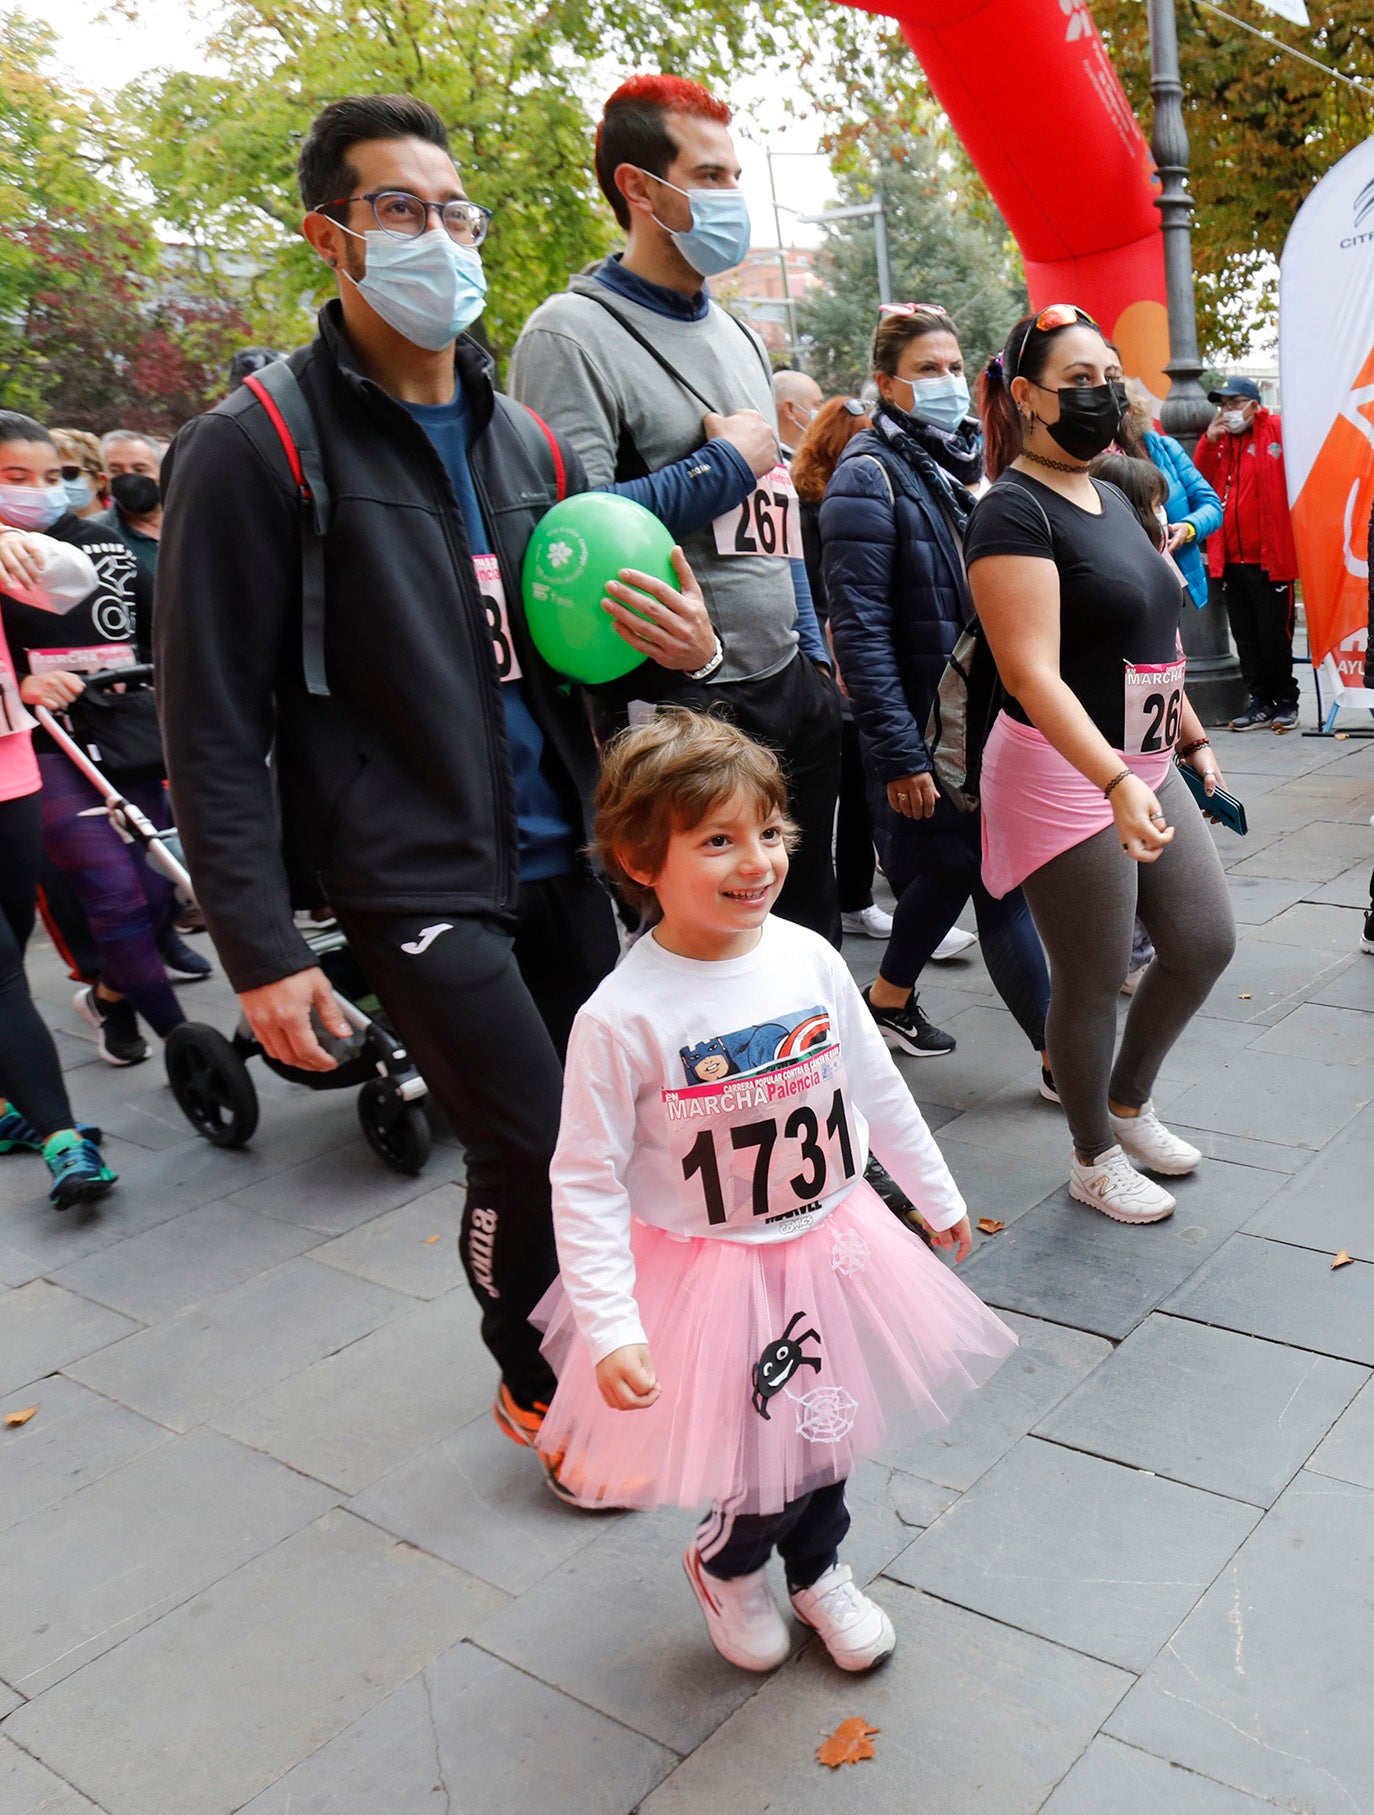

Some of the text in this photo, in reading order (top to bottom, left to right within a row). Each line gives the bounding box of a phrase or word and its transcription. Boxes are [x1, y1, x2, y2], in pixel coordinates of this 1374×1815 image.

[735, 489, 789, 554] 267
[668, 1086, 769, 1121] MARCHA
[767, 1070, 821, 1102] Palencia
[723, 1082, 755, 1094] CARRERA
[755, 1073, 782, 1089] POPULAR
[782, 1066, 806, 1081] CONTRA
[681, 1088, 856, 1226] 1731
[780, 1215, 814, 1234] COMICS
